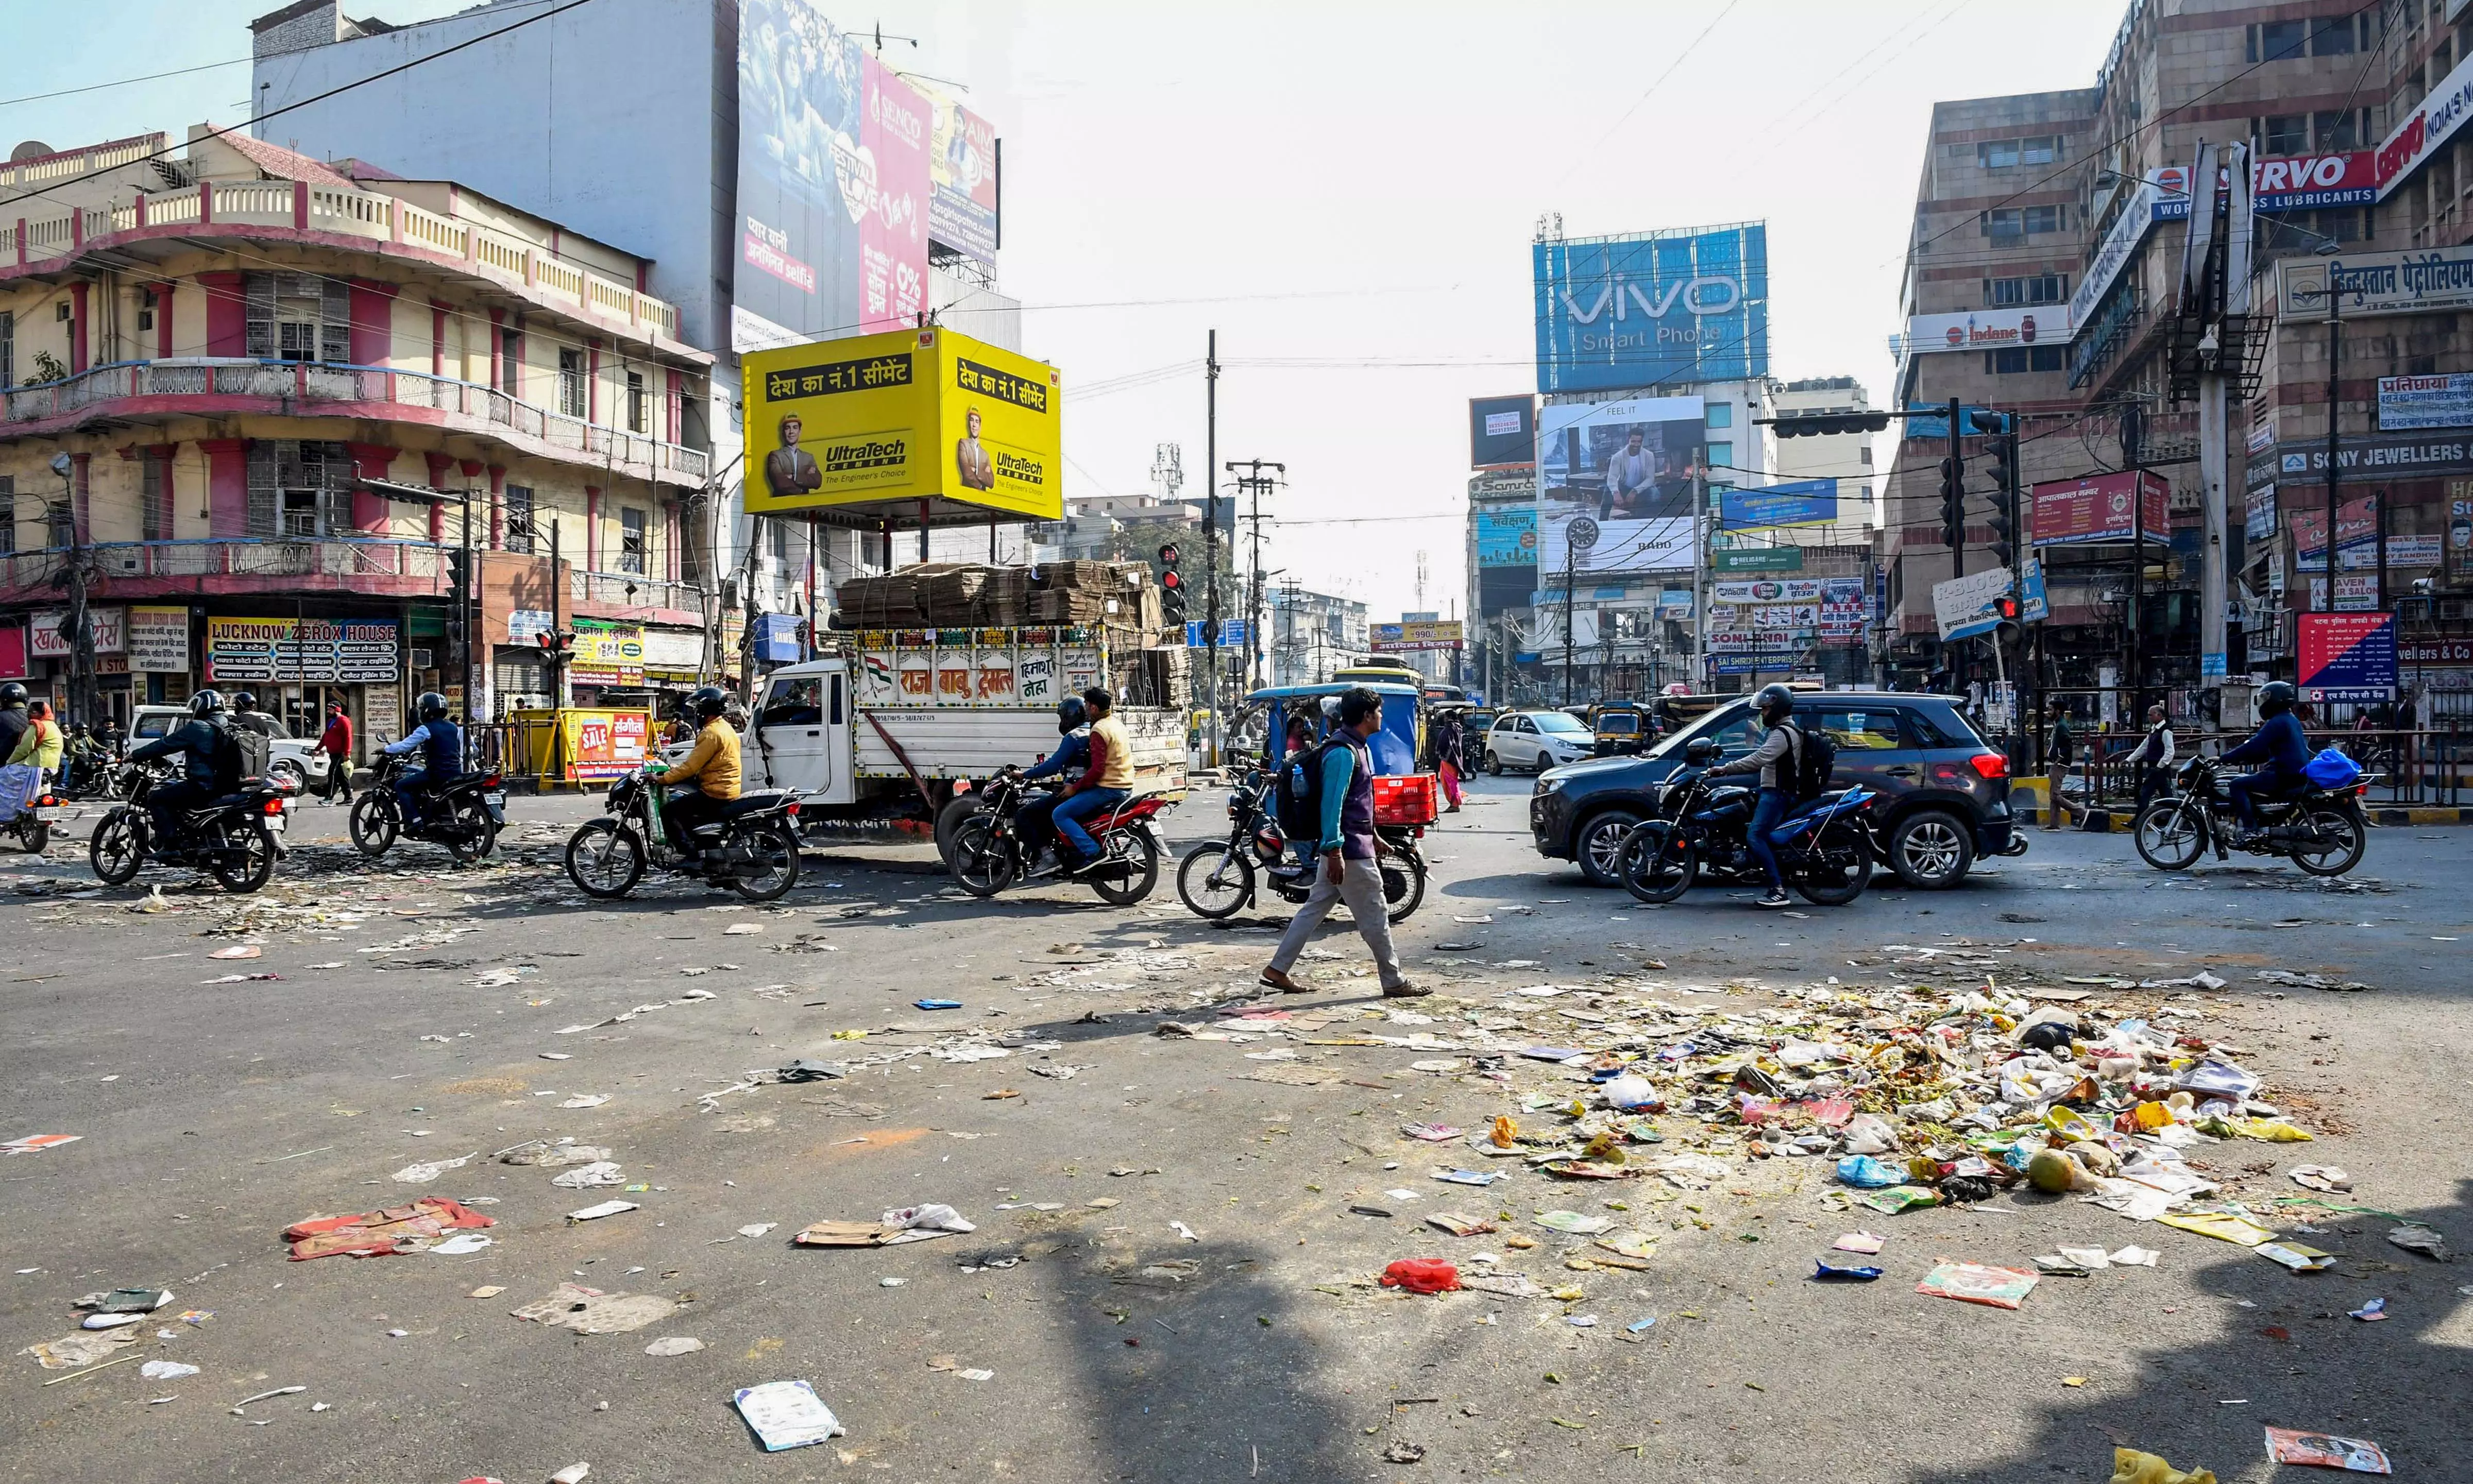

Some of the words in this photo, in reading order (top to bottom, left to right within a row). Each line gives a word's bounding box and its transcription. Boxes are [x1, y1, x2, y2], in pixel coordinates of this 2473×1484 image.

[882, 95, 921, 139] SENCO
[2425, 92, 2461, 143] INDIA'S
[931, 148, 943, 160] ool
[828, 143, 873, 184] FESTIVAL
[931, 156, 943, 170] IRLS
[845, 171, 878, 212] LOVE
[2161, 205, 2191, 215] WOR
[2276, 190, 2371, 207] LUBRICANTS
[2124, 187, 2149, 242] LIMITED
[747, 215, 767, 242] प्यार
[768, 228, 787, 253] यानी
[748, 241, 784, 274] अनगिनत
[785, 264, 813, 289] selfie
[2329, 260, 2396, 306] हिन्दुस्तान
[1559, 271, 1740, 324] vivo
[1583, 330, 1646, 351] Smart
[1657, 326, 1721, 345] Phone
[1969, 325, 2018, 342] Indane
[770, 374, 797, 397] देश
[802, 374, 824, 393] का
[862, 357, 907, 385] सीमेंट
[960, 361, 978, 389] देश
[981, 374, 996, 395] का
[1019, 382, 1044, 410] सीमेंट
[1607, 407, 1625, 416] FEEL
[1628, 406, 1636, 415] IT
[826, 439, 905, 462] UltraTech
[2364, 443, 2463, 466] JEWELLERS
[829, 457, 902, 470] CEMENT
[996, 451, 1043, 476] UltraTech
[841, 472, 878, 483] Engineer's
[880, 469, 906, 479] Choice
[998, 467, 1041, 484] CEMENT
[996, 480, 1005, 488] The
[1006, 481, 1028, 493] Engineer's
[1028, 487, 1043, 497] Choice
[2037, 490, 2077, 504] आपातकाल
[2078, 487, 2099, 499] नम्बर
[2087, 531, 2107, 539] आपकी
[1638, 541, 1671, 550] RADO
[1787, 583, 1818, 591] वैक्सीन
[2335, 578, 2365, 587] AVEN
[1790, 589, 1814, 598] हाउस
[2348, 587, 2378, 595] SALON
[1823, 603, 1861, 612] N.T.T.
[1944, 618, 1967, 631] कृपया
[2331, 617, 2347, 626] पुलिस
[2350, 616, 2368, 624] आपकी
[94, 615, 122, 647] टोर्स
[211, 623, 284, 639] LUCKNOW
[291, 624, 342, 641] ZEROX
[346, 625, 397, 641] HOUSE
[608, 628, 641, 640] स्टुडियो
[774, 632, 796, 644] SAMSU
[1711, 633, 1747, 643] SONI
[216, 642, 242, 651] फोटो
[245, 642, 268, 652] स्टेट
[317, 644, 332, 652] स्टेट
[380, 644, 393, 653] प्रिंट
[1379, 641, 1419, 650] आदित्य
[2441, 645, 2450, 659] &
[2454, 645, 2470, 659] Co
[107, 658, 128, 672] STO
[252, 656, 269, 664] कॉपी
[1718, 658, 1729, 666] SAI
[245, 670, 267, 678] स्कैन
[1021, 659, 1053, 678] हिमांशु
[901, 669, 933, 695] राजा
[1022, 679, 1048, 697] नेहा
[446, 688, 460, 697] PHOTO
[2339, 690, 2347, 698] डी
[2361, 690, 2370, 698] सी
[2373, 689, 2385, 698] बैंक
[614, 717, 645, 734] संगीता
[582, 728, 607, 749] SALE
